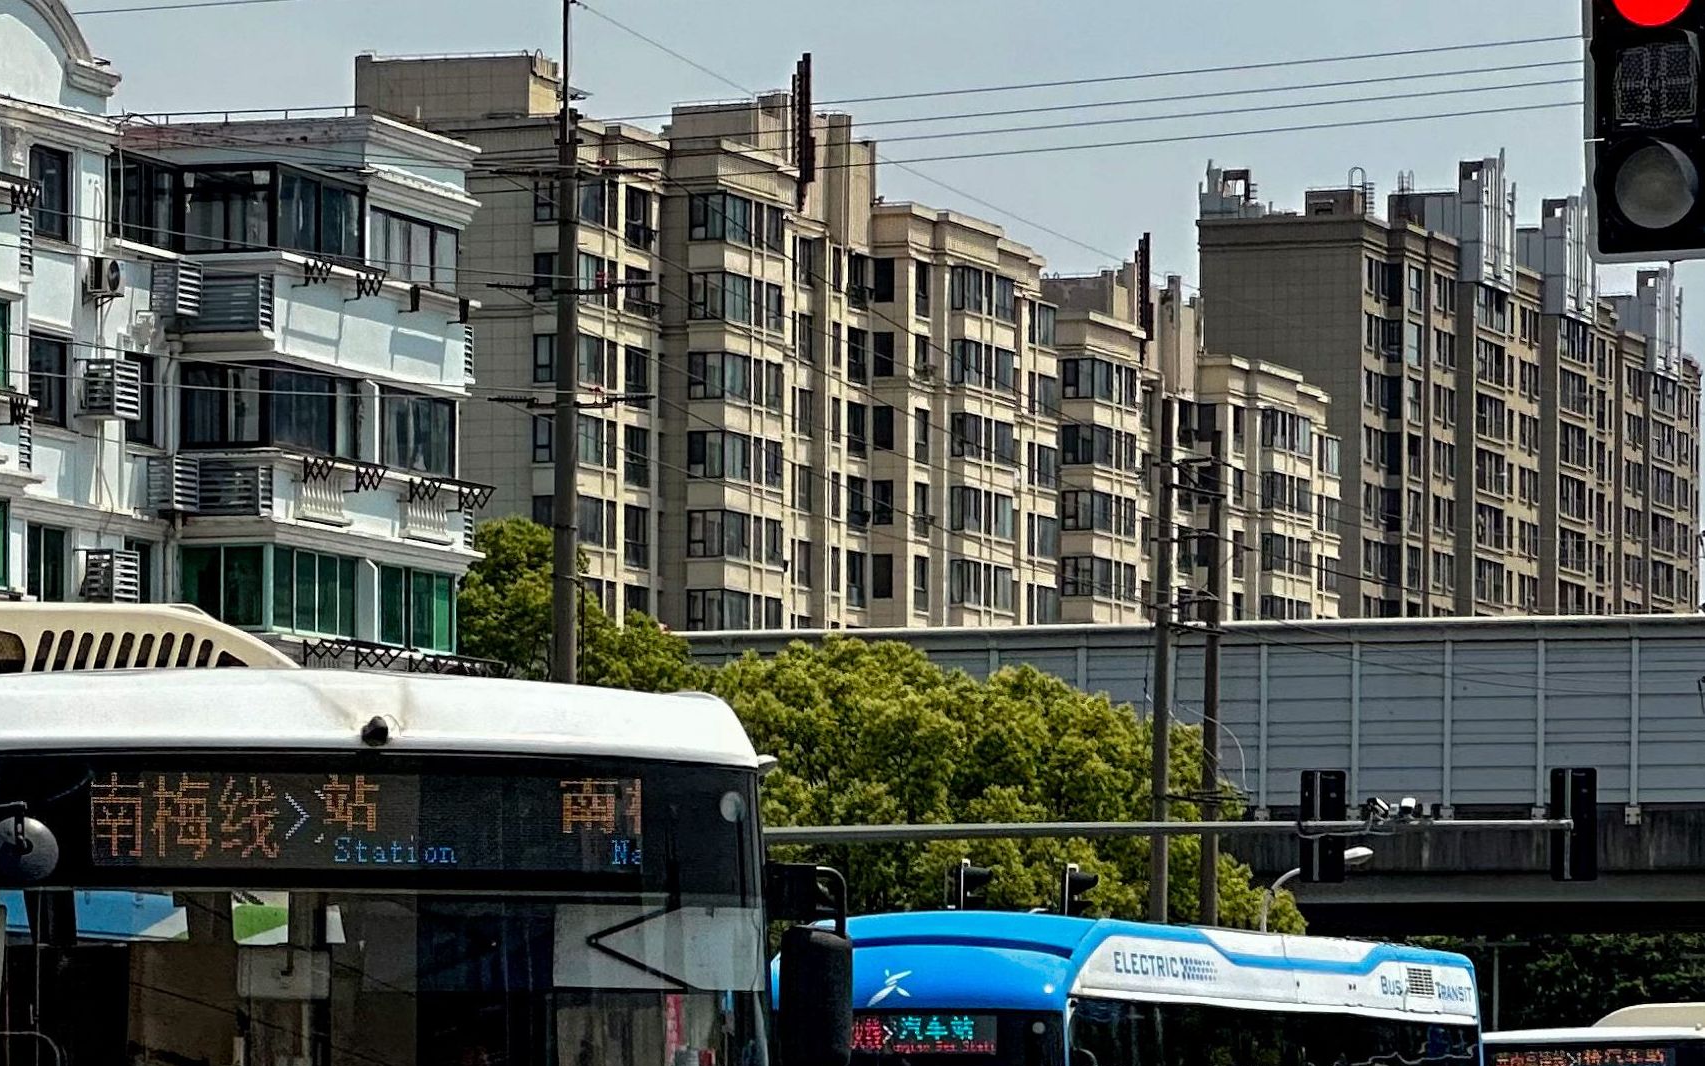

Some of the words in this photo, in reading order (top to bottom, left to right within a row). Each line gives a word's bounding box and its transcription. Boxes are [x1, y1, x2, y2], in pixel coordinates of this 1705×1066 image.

[90, 772, 280, 861] 南梅线
[323, 773, 381, 833] 站
[333, 836, 459, 875] Station
[1113, 950, 1180, 980] ELECTRIC
